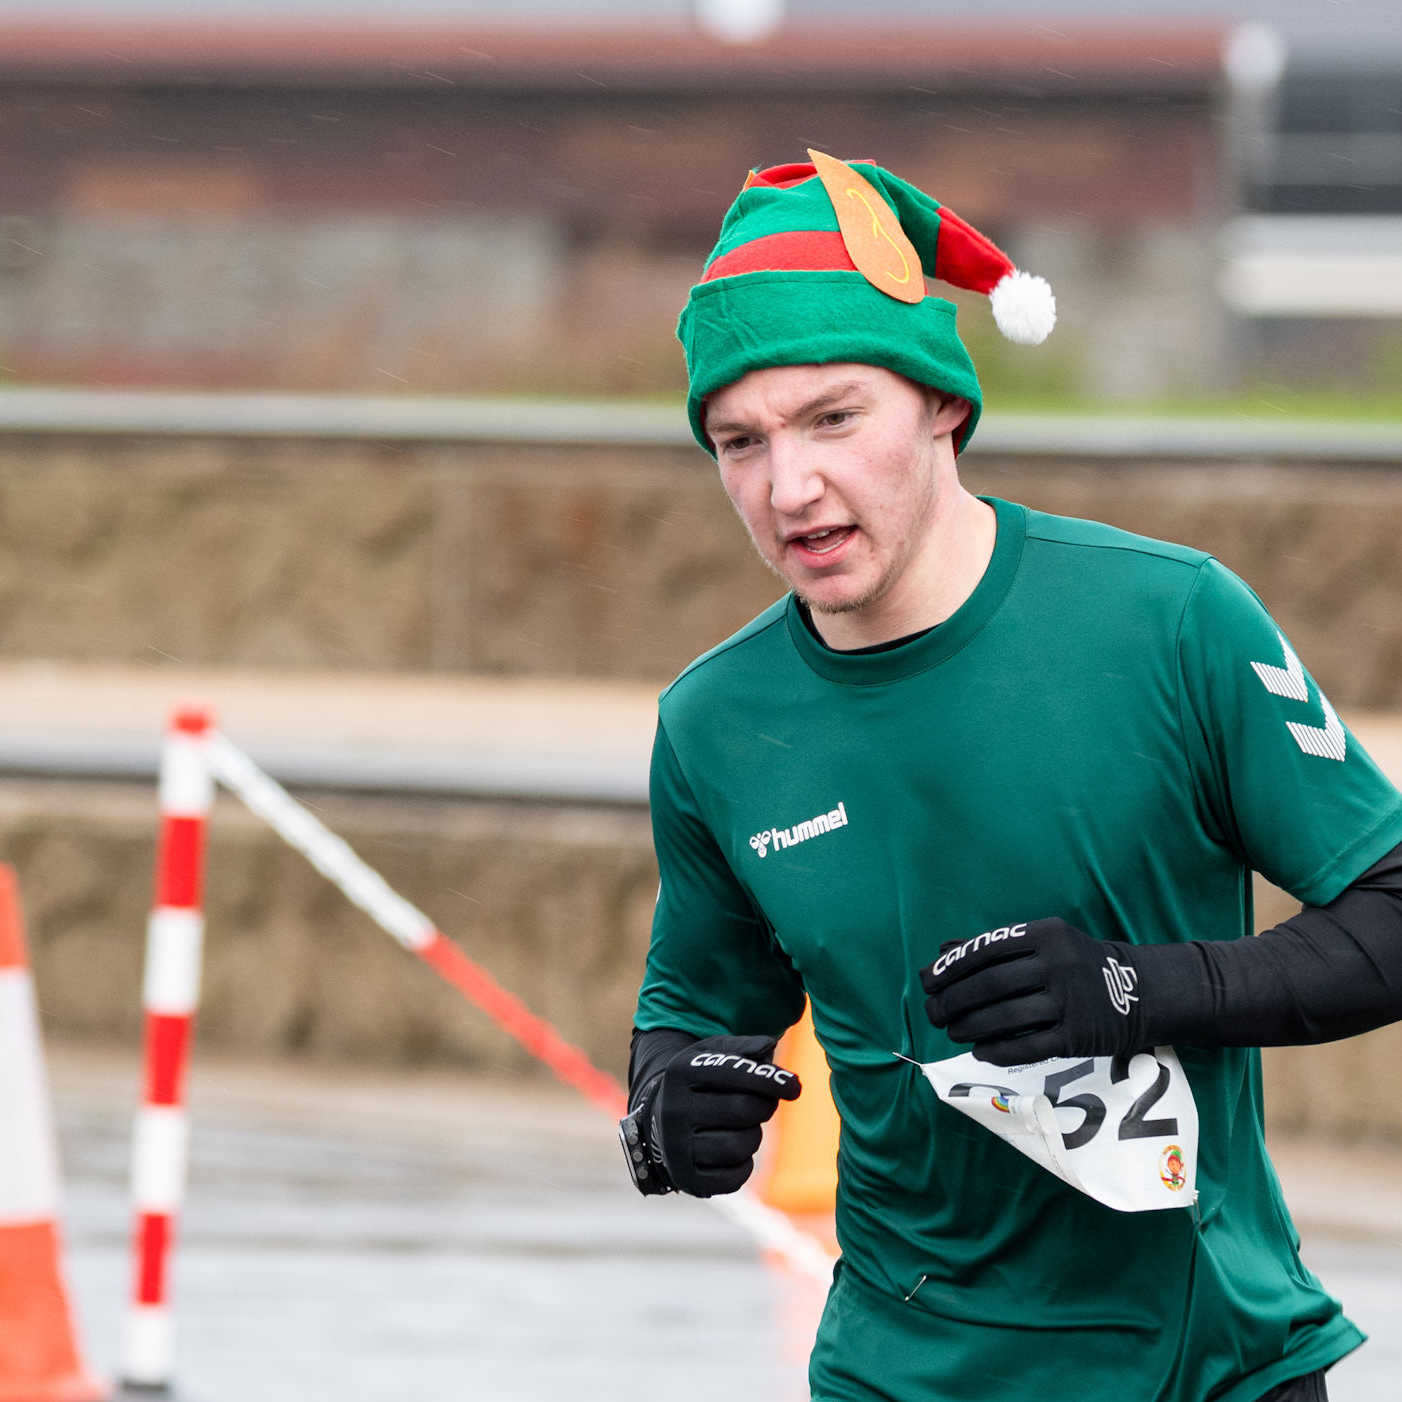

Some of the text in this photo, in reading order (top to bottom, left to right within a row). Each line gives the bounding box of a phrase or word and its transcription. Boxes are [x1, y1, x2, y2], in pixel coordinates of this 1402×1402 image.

[771, 801, 848, 851] hummel
[932, 922, 1028, 976] carnac
[690, 1053, 794, 1085] carnac
